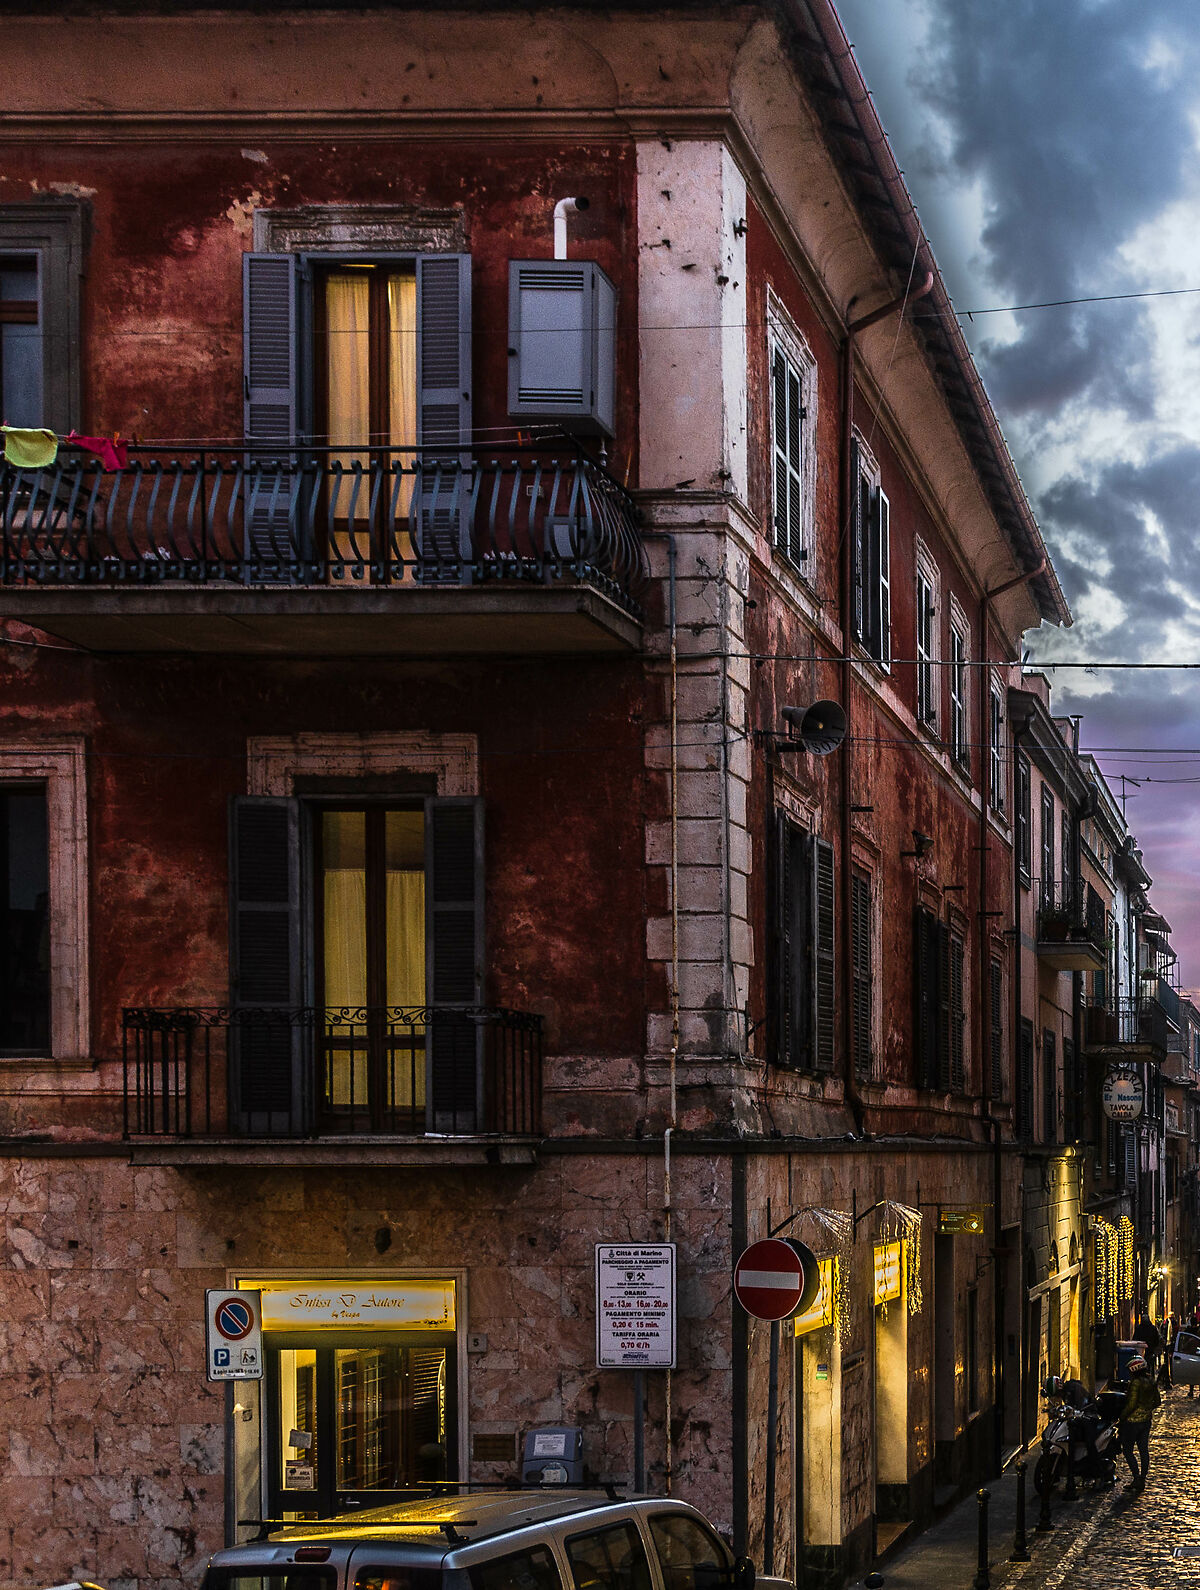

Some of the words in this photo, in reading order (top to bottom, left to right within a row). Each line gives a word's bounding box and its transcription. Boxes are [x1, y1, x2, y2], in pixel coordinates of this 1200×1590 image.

[1103, 1071, 1142, 1093] PIZZERIA
[1104, 1093, 1112, 1101] Er
[612, 1321, 626, 1329] 0,20
[473, 1338, 480, 1347] 5
[217, 1350, 227, 1365] P
